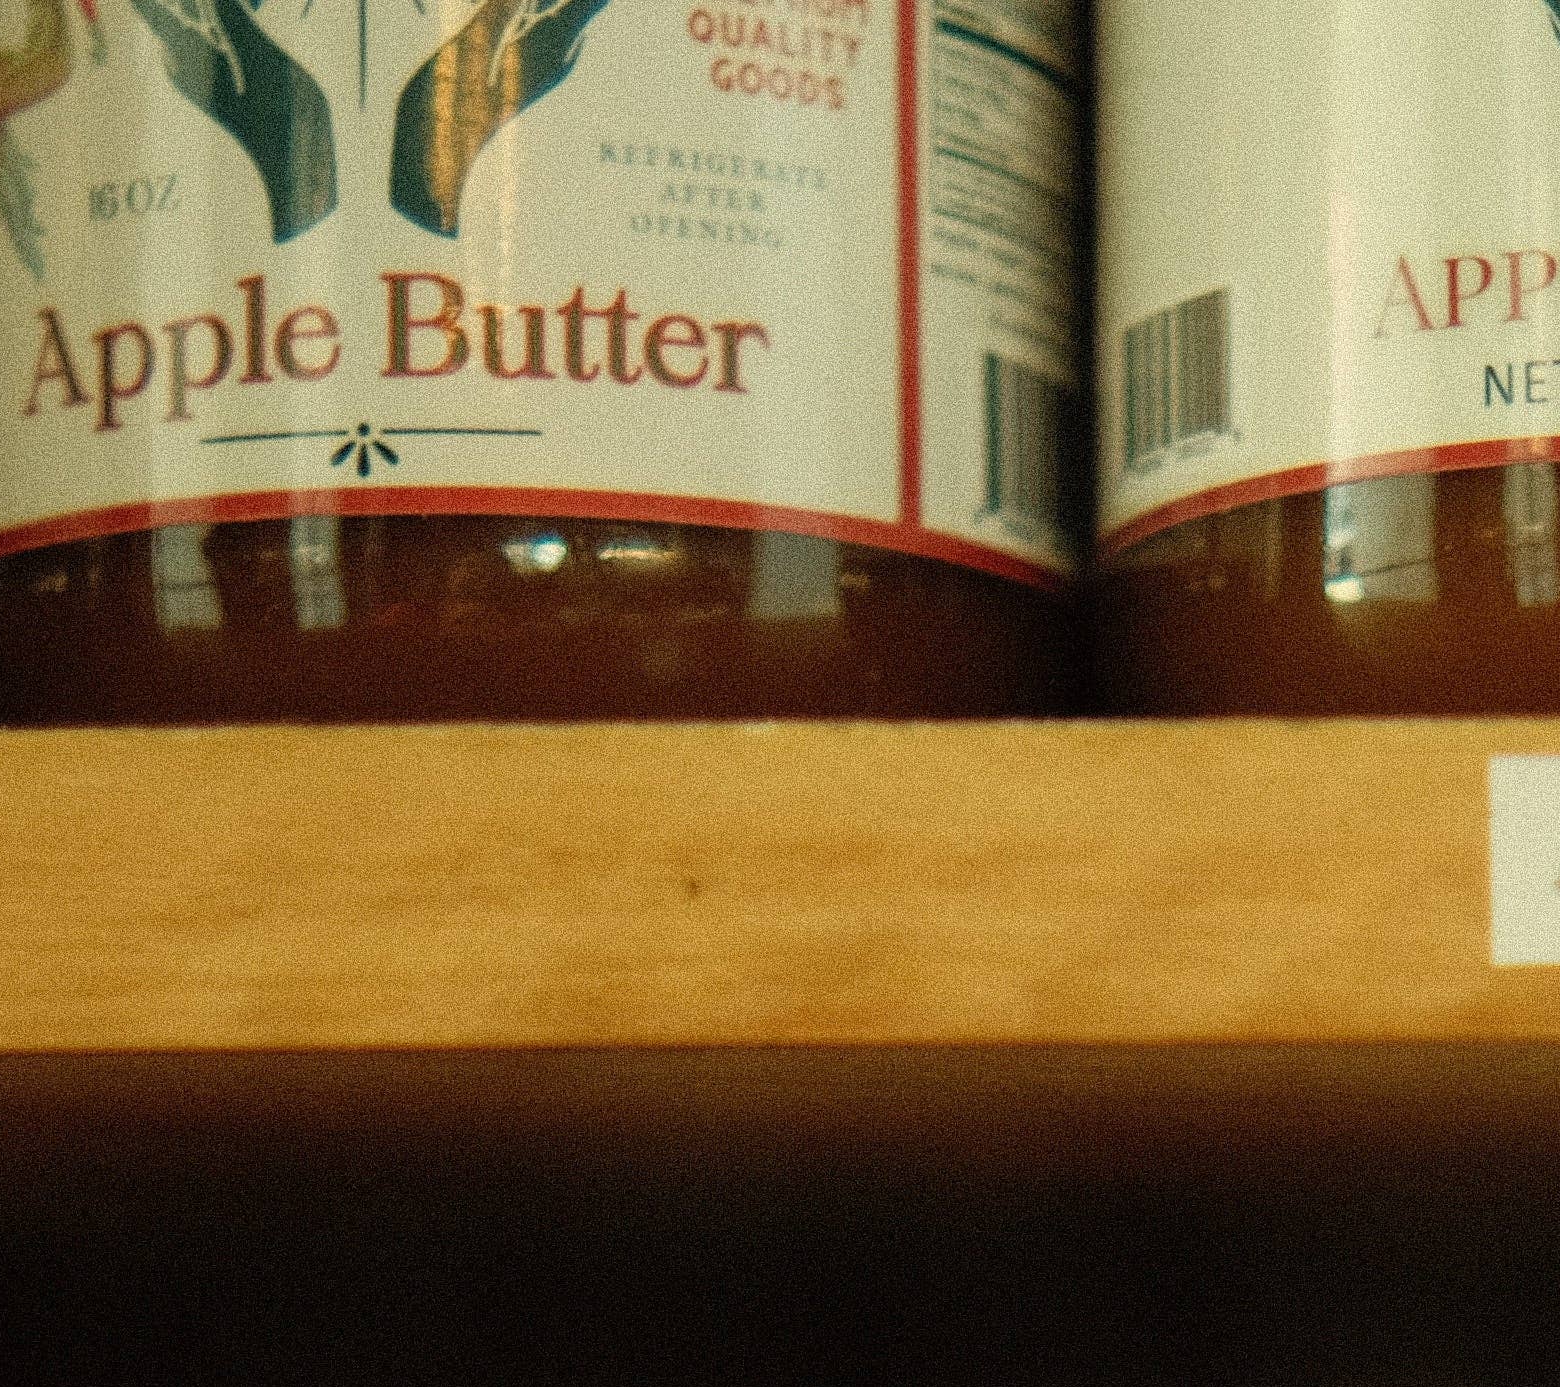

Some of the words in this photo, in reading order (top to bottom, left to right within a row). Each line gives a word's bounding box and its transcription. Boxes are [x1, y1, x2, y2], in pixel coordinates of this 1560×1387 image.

[686, 8, 864, 67] QUALITY
[709, 56, 845, 112] GOODS
[22, 276, 343, 432] Apple
[380, 270, 770, 397] Butter
